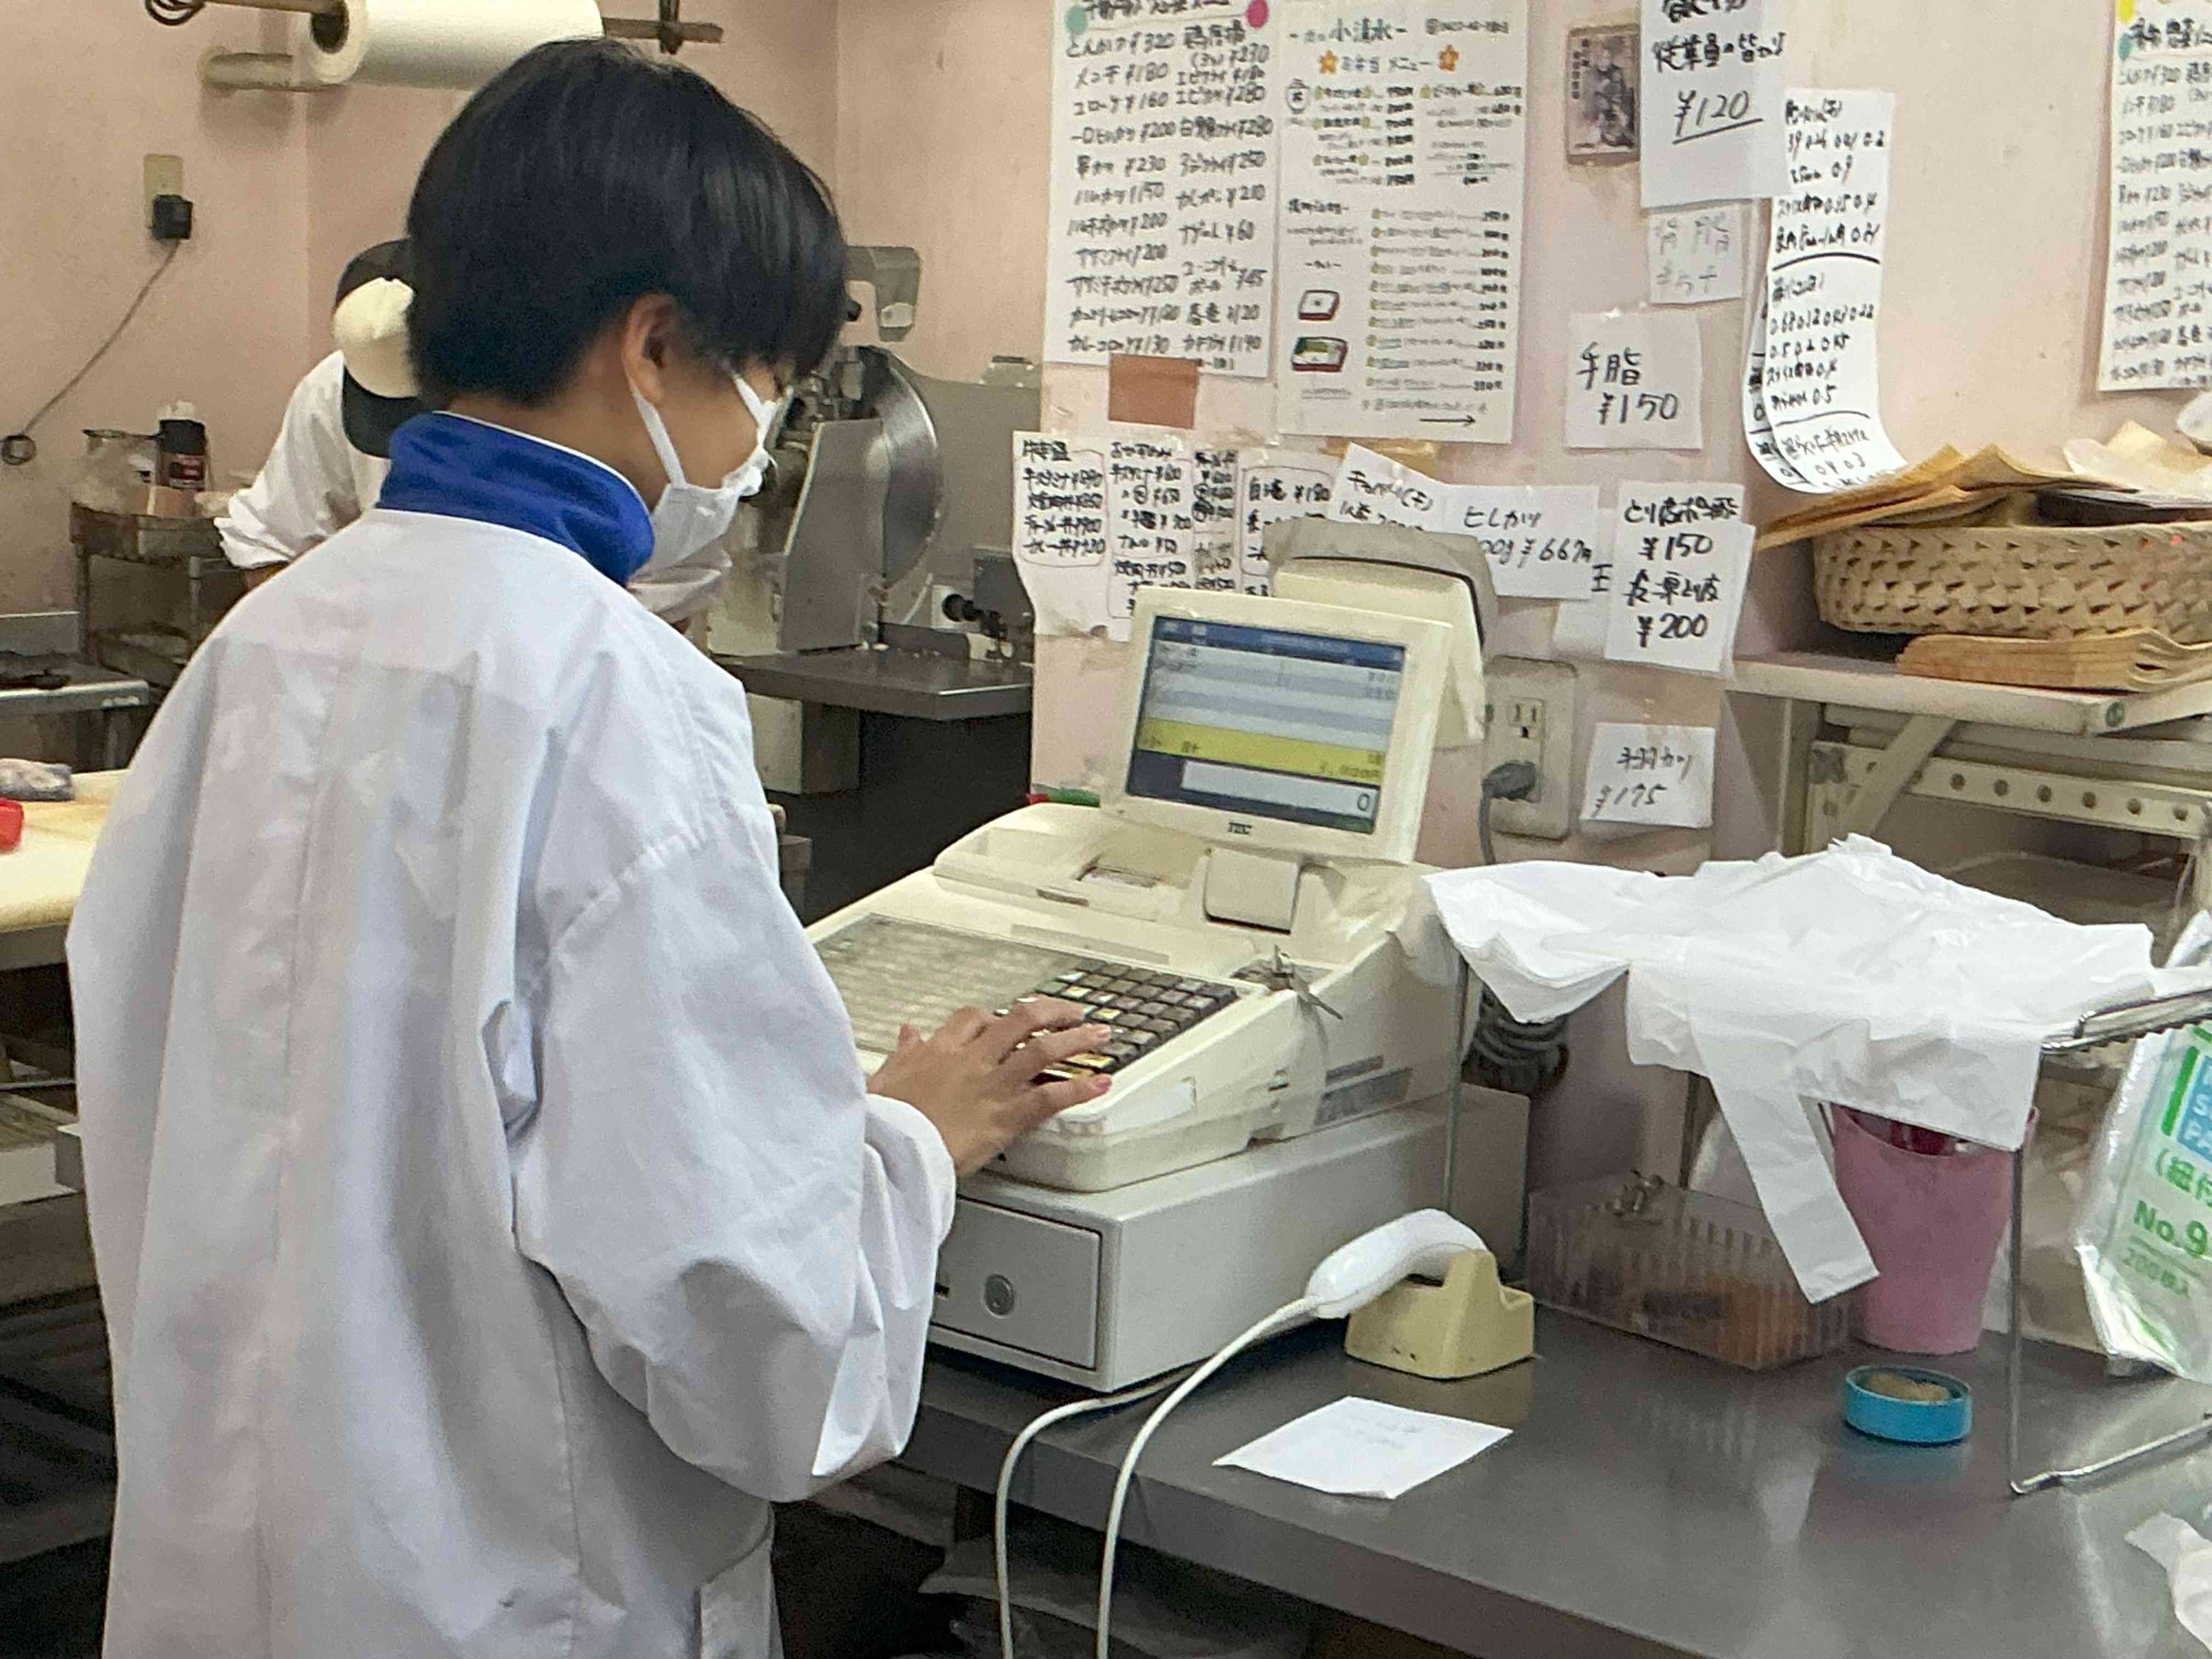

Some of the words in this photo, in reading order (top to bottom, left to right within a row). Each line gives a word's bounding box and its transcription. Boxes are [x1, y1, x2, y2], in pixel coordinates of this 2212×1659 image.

[1674, 89, 1750, 137] ¥120
[1598, 392, 1679, 425] ¥150
[1638, 531, 1713, 561] ¥150
[1637, 612, 1708, 648] ¥200
[2132, 1199, 2209, 1257] No.9
